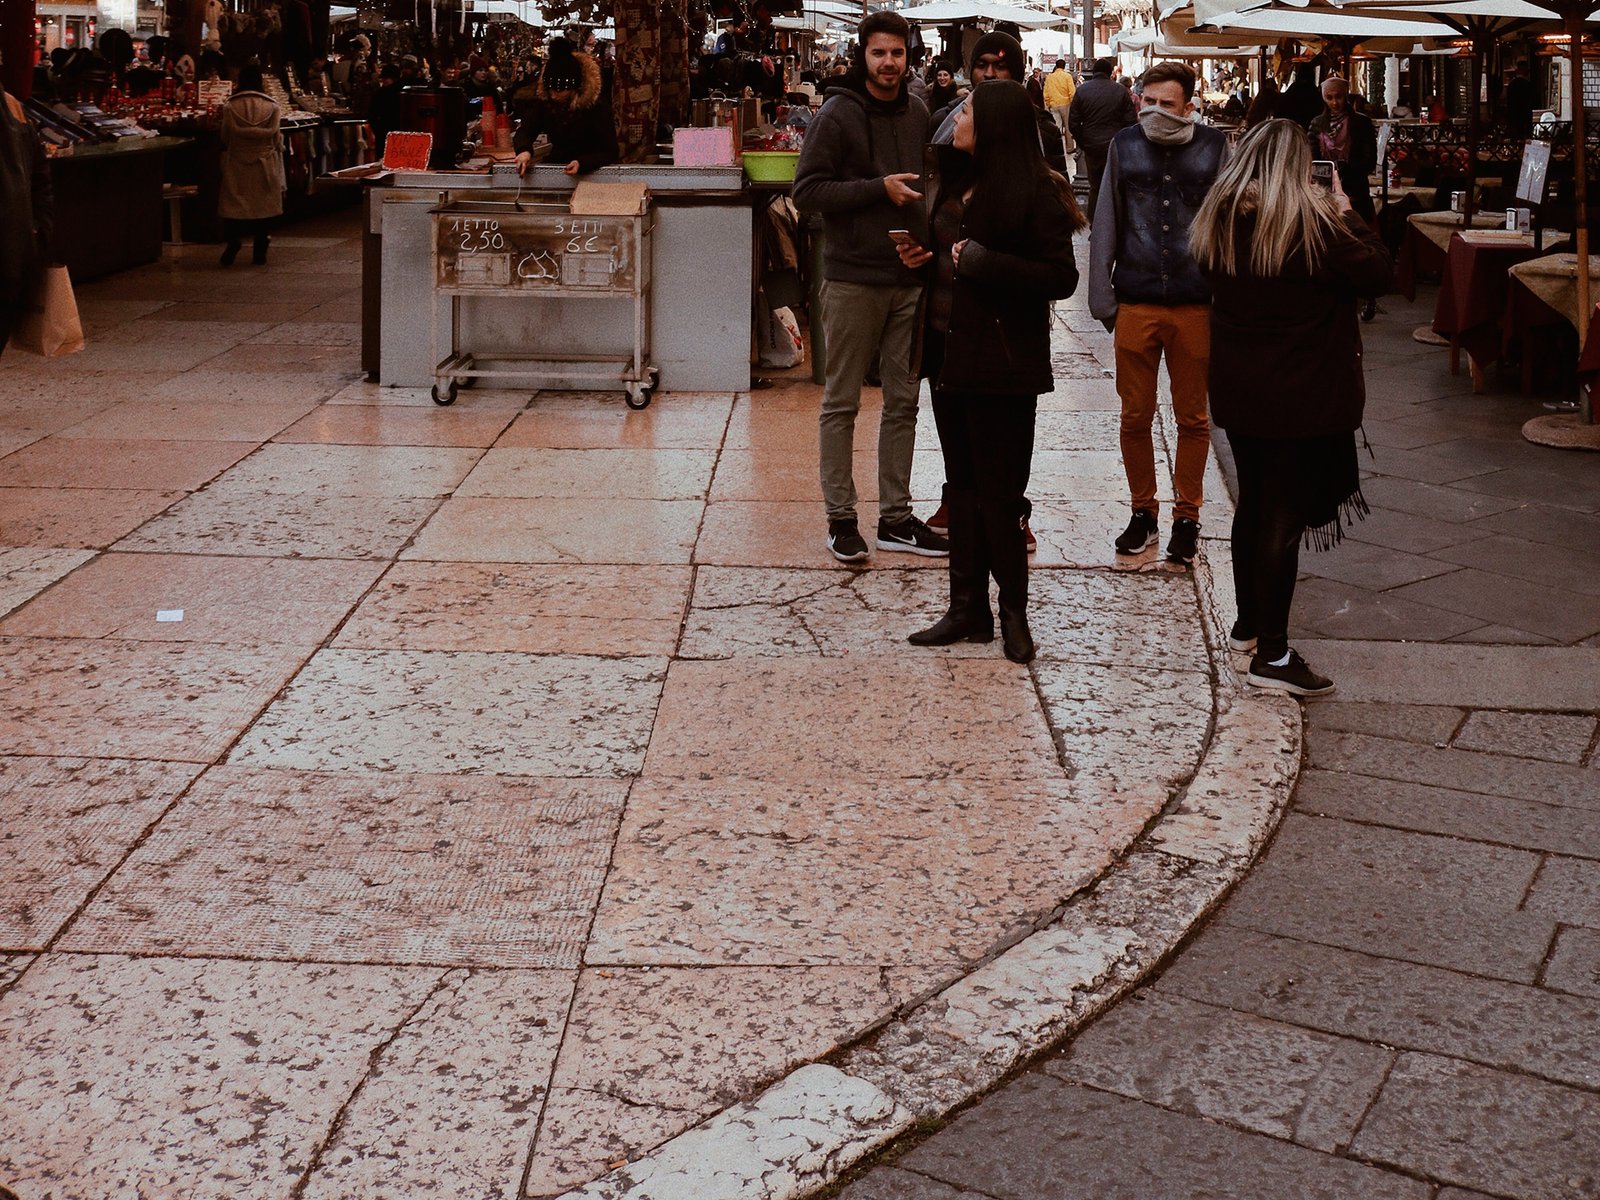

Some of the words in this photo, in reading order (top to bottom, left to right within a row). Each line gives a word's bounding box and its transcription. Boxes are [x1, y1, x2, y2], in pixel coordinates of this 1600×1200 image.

[452, 220, 459, 232] 1
[463, 218, 499, 231] ETTO
[554, 219, 564, 234] 3
[570, 219, 602, 234] ETTI
[460, 231, 504, 253] 2,50
